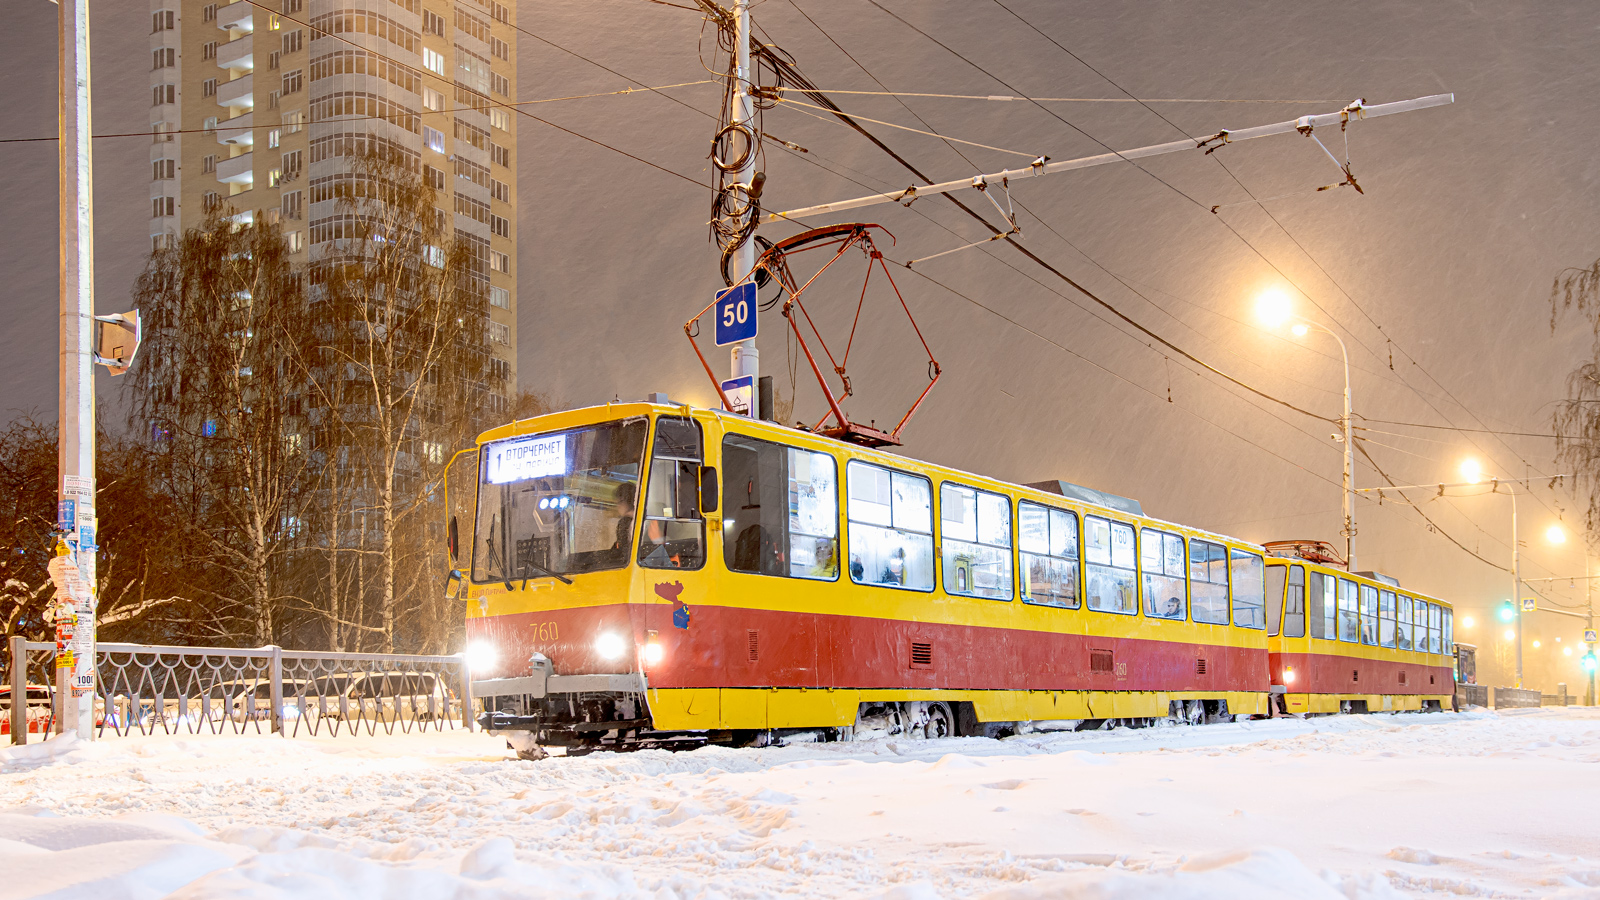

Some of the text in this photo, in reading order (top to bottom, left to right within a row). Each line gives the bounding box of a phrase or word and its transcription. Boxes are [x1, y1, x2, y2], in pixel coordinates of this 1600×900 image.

[723, 300, 748, 327] 50
[506, 440, 562, 460] ВТОРЧЕРМЕТ
[496, 453, 502, 473] 1
[1114, 529, 1127, 544] 760
[530, 622, 558, 642] 760
[1116, 662, 1127, 676] 760
